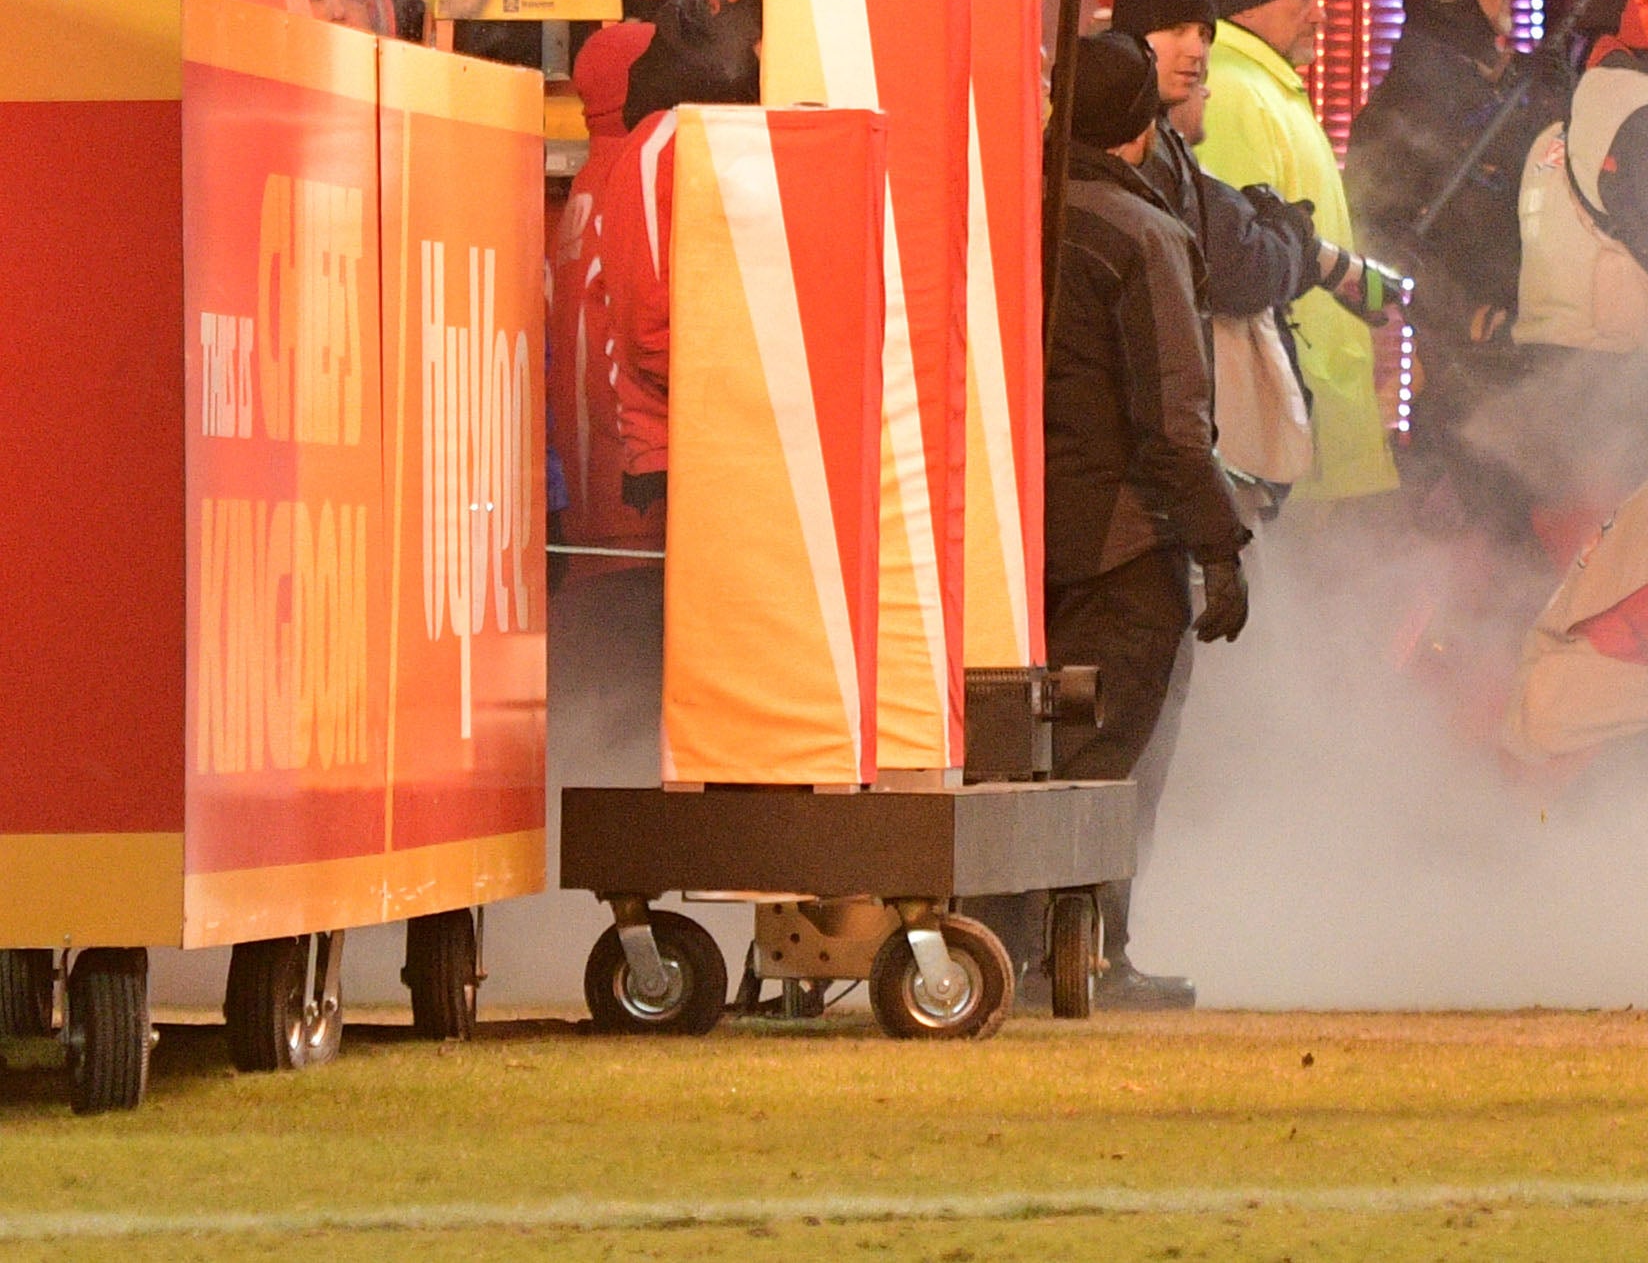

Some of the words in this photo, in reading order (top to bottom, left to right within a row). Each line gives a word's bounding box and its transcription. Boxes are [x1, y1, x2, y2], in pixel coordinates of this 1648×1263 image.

[201, 311, 238, 438] THIS
[258, 173, 363, 446] CHIEFS
[199, 498, 368, 774] KINGDOM
